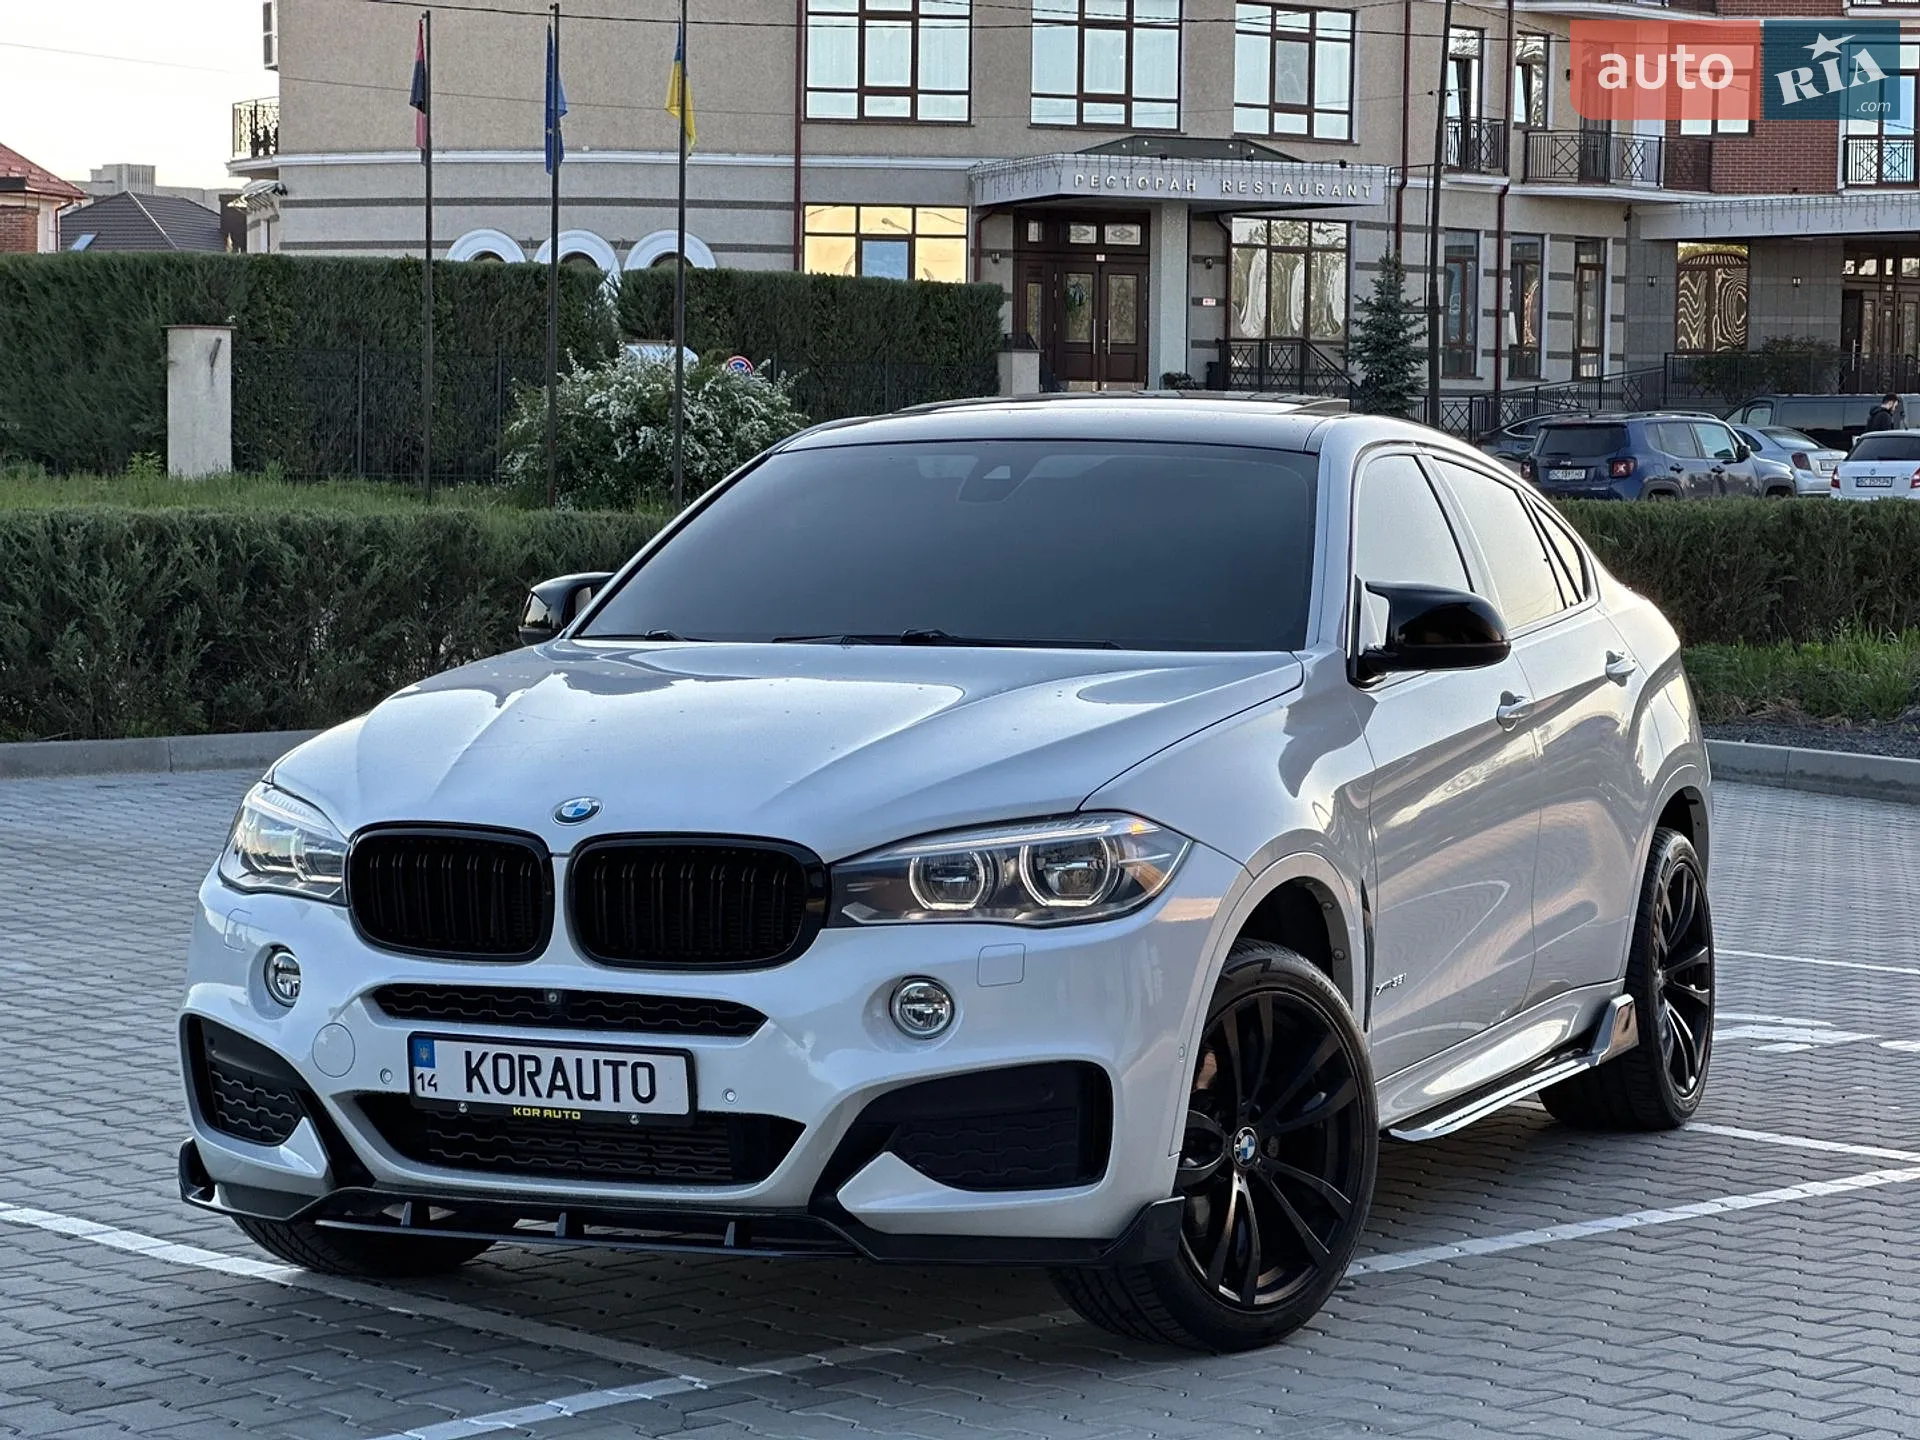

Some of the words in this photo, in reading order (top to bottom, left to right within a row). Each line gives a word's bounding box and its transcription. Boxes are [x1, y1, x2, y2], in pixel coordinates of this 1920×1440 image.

[1074, 174, 1197, 192] РЕСТОРАН
[1221, 177, 1372, 198] RESTAURANT
[416, 1072, 438, 1093] 14
[464, 1050, 656, 1104] KORAUTO
[513, 1106, 541, 1117] KOR
[543, 1107, 581, 1120] AUTO
